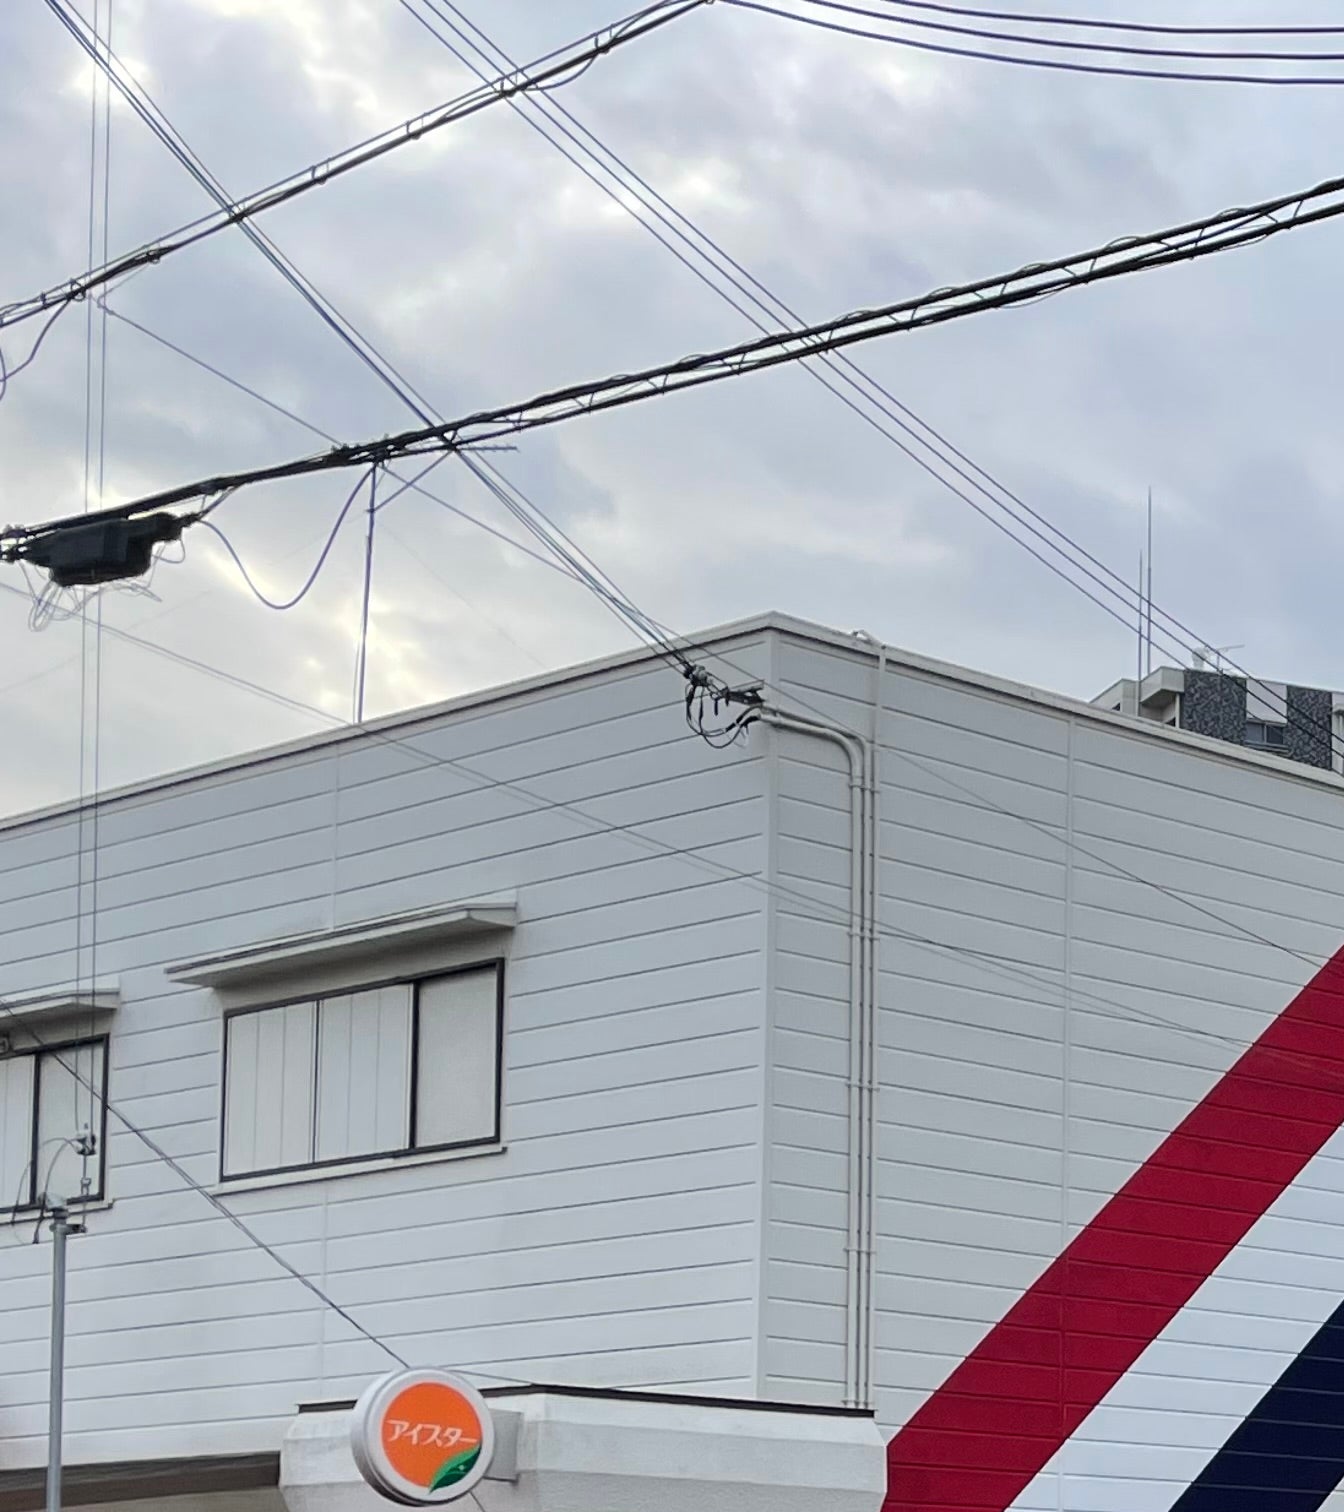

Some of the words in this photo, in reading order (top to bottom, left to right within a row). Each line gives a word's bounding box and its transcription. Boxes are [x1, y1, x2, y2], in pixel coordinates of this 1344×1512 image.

[384, 1419, 479, 1448] アイスター
